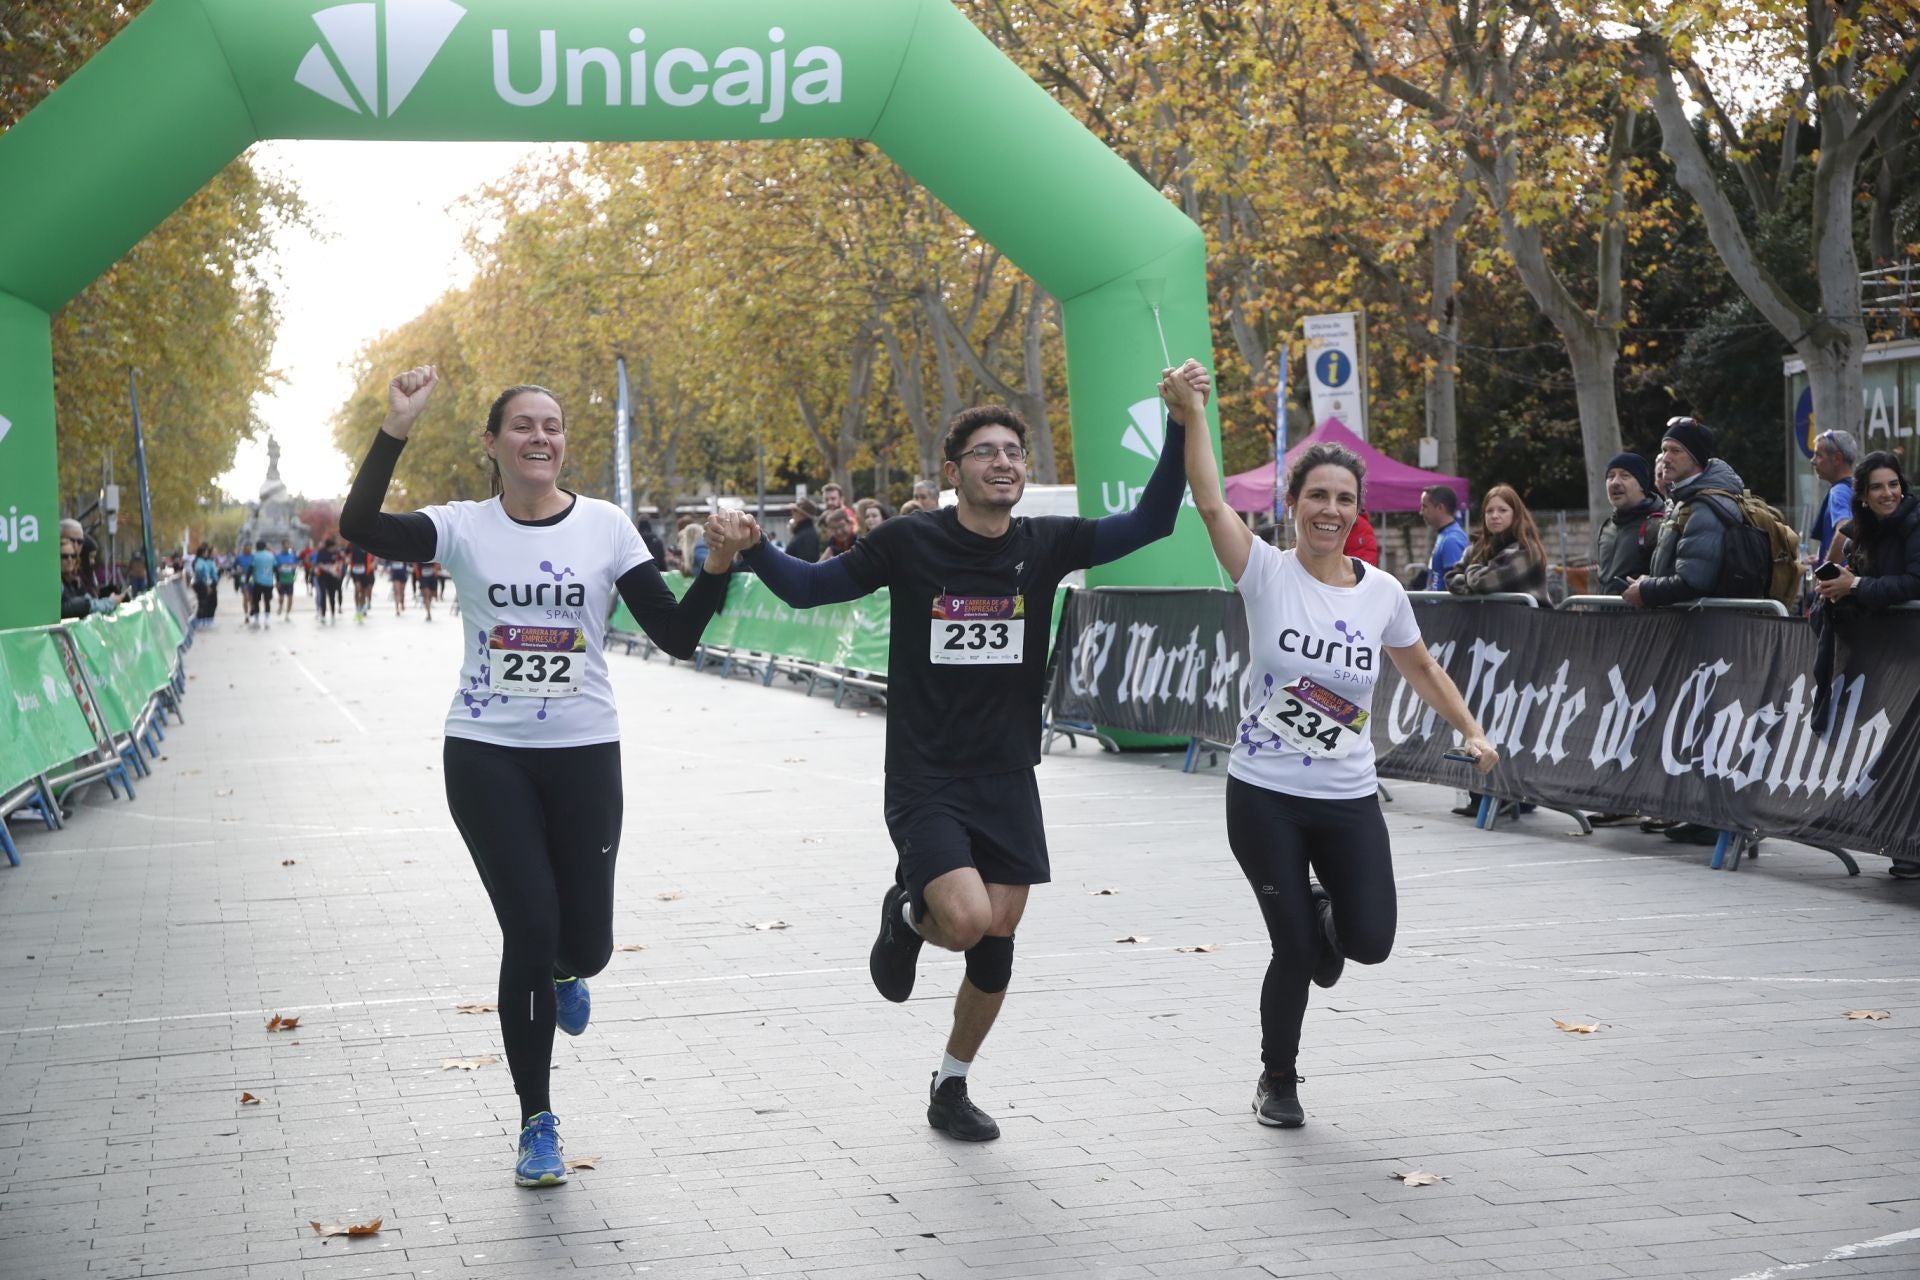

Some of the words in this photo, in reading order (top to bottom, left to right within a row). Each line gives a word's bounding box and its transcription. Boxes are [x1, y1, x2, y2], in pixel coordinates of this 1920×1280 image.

[492, 27, 842, 123] Unicaja
[487, 583, 585, 608] curia
[964, 605, 998, 613] EMPRESAS
[546, 609, 582, 620] SPAIN
[521, 634, 558, 643] EMPRESAS
[944, 623, 1009, 650] 233
[1278, 628, 1373, 671] curia
[503, 653, 571, 683] 232
[1117, 621, 1206, 705] Norte
[1333, 669, 1373, 686] SPAIN
[1276, 699, 1342, 751] 234
[1453, 638, 1587, 765] Norte
[1588, 664, 1656, 771] de
[1661, 657, 1891, 801] Castilla
